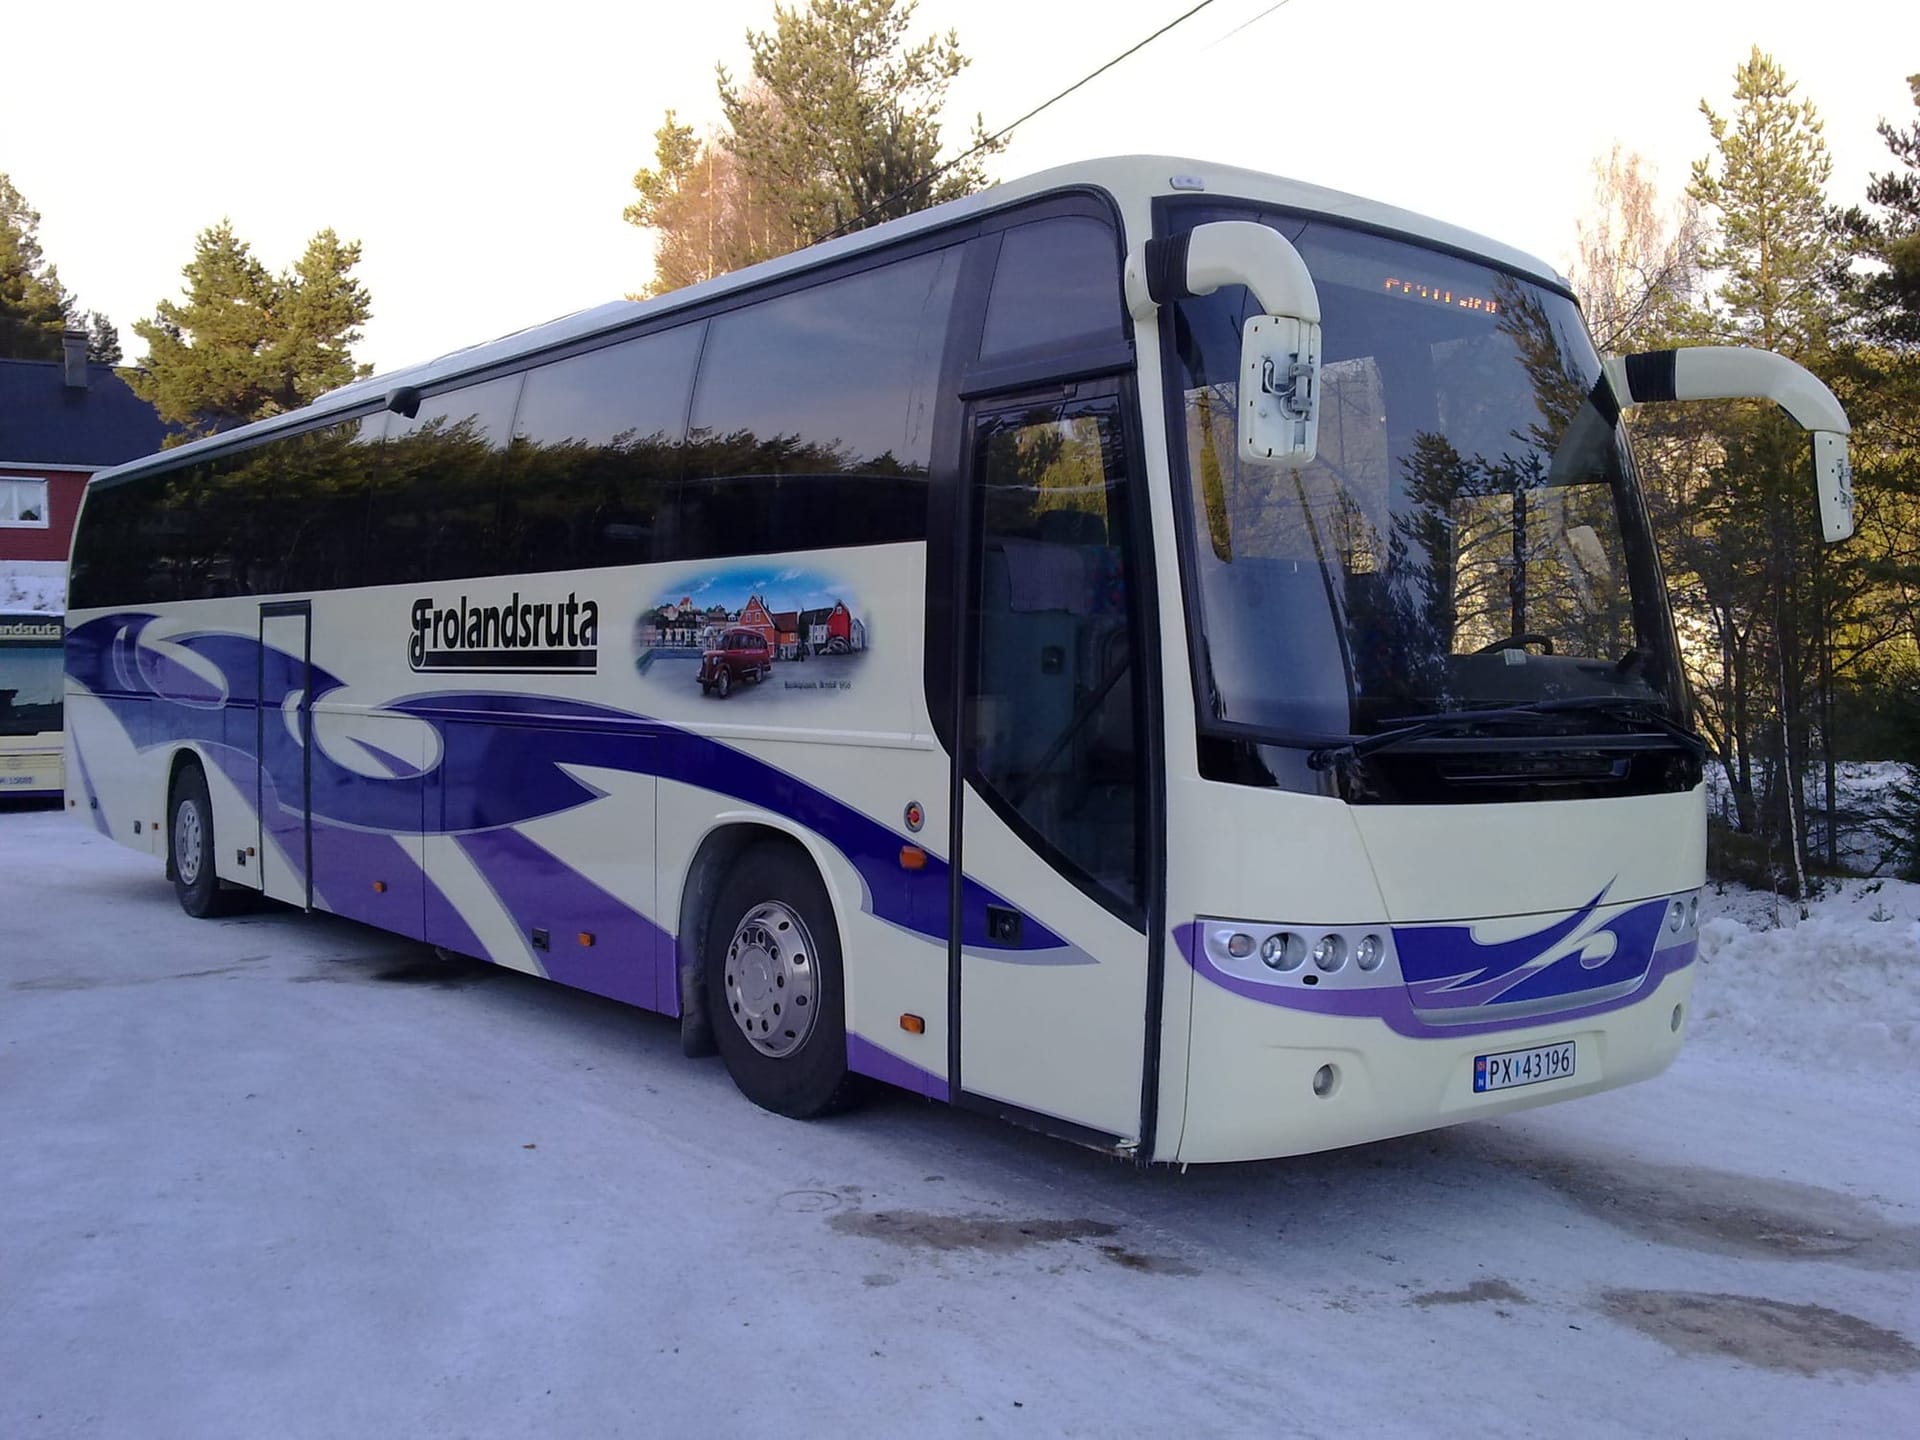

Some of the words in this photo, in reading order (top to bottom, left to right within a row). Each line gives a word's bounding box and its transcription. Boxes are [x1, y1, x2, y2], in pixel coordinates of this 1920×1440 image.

[411, 592, 598, 667] Frolandsruta
[1489, 1057, 1512, 1086] PX
[1522, 1047, 1570, 1079] 43196
